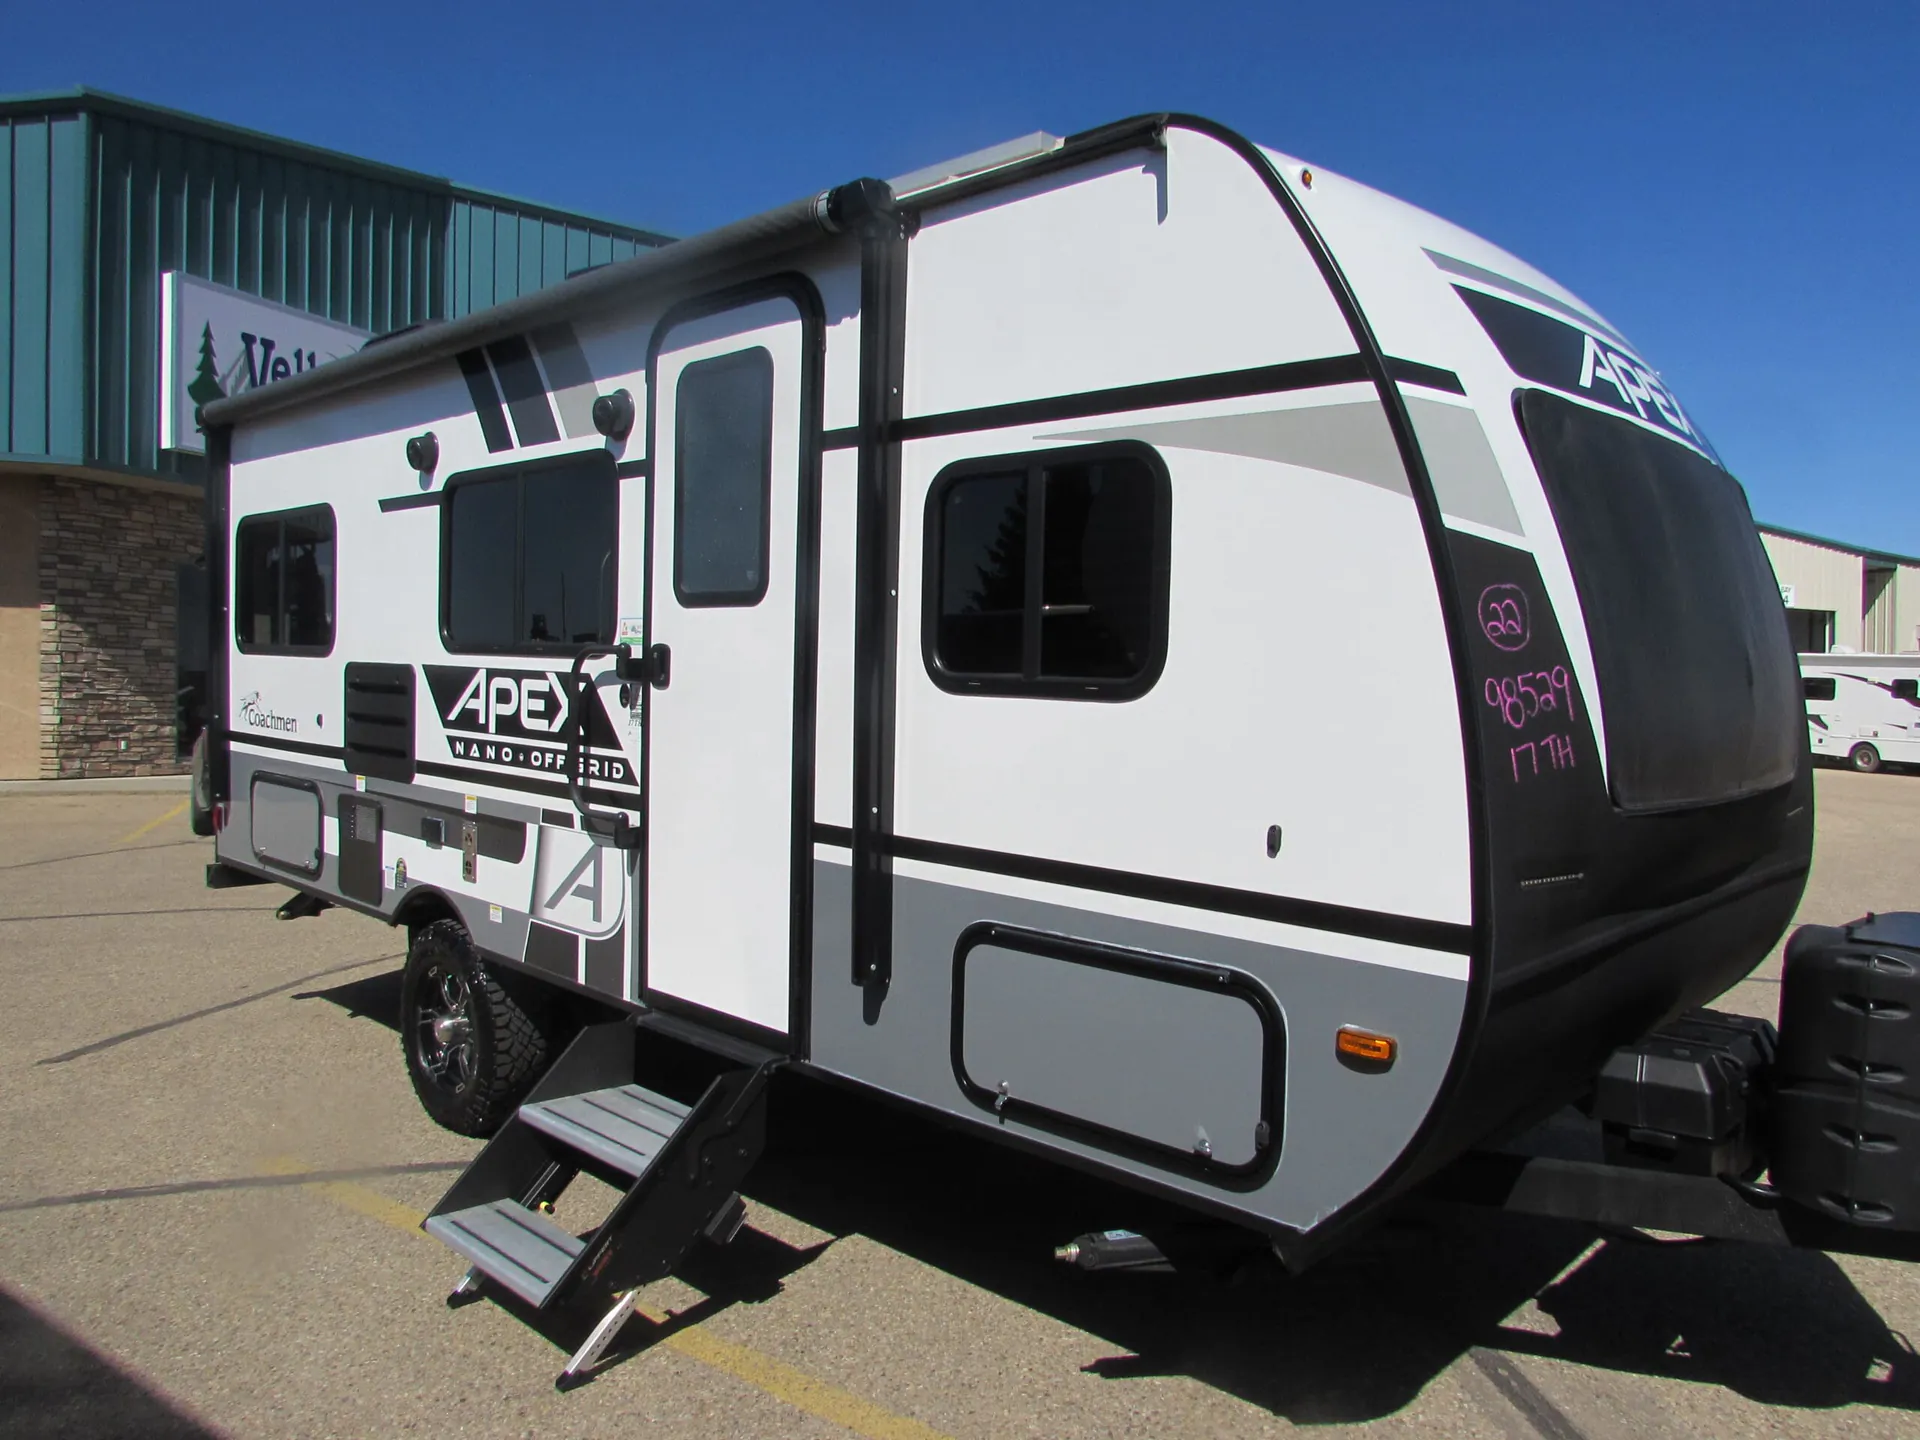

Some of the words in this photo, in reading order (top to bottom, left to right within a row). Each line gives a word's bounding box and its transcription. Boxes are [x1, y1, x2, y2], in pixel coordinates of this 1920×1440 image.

[1579, 333, 1702, 446] APEX
[1486, 599, 1521, 637] 22
[248, 708, 298, 733] Coachmen
[446, 668, 587, 734] APEX
[1484, 665, 1574, 728] 98529
[455, 741, 514, 764] NANO
[530, 751, 566, 771] OFF
